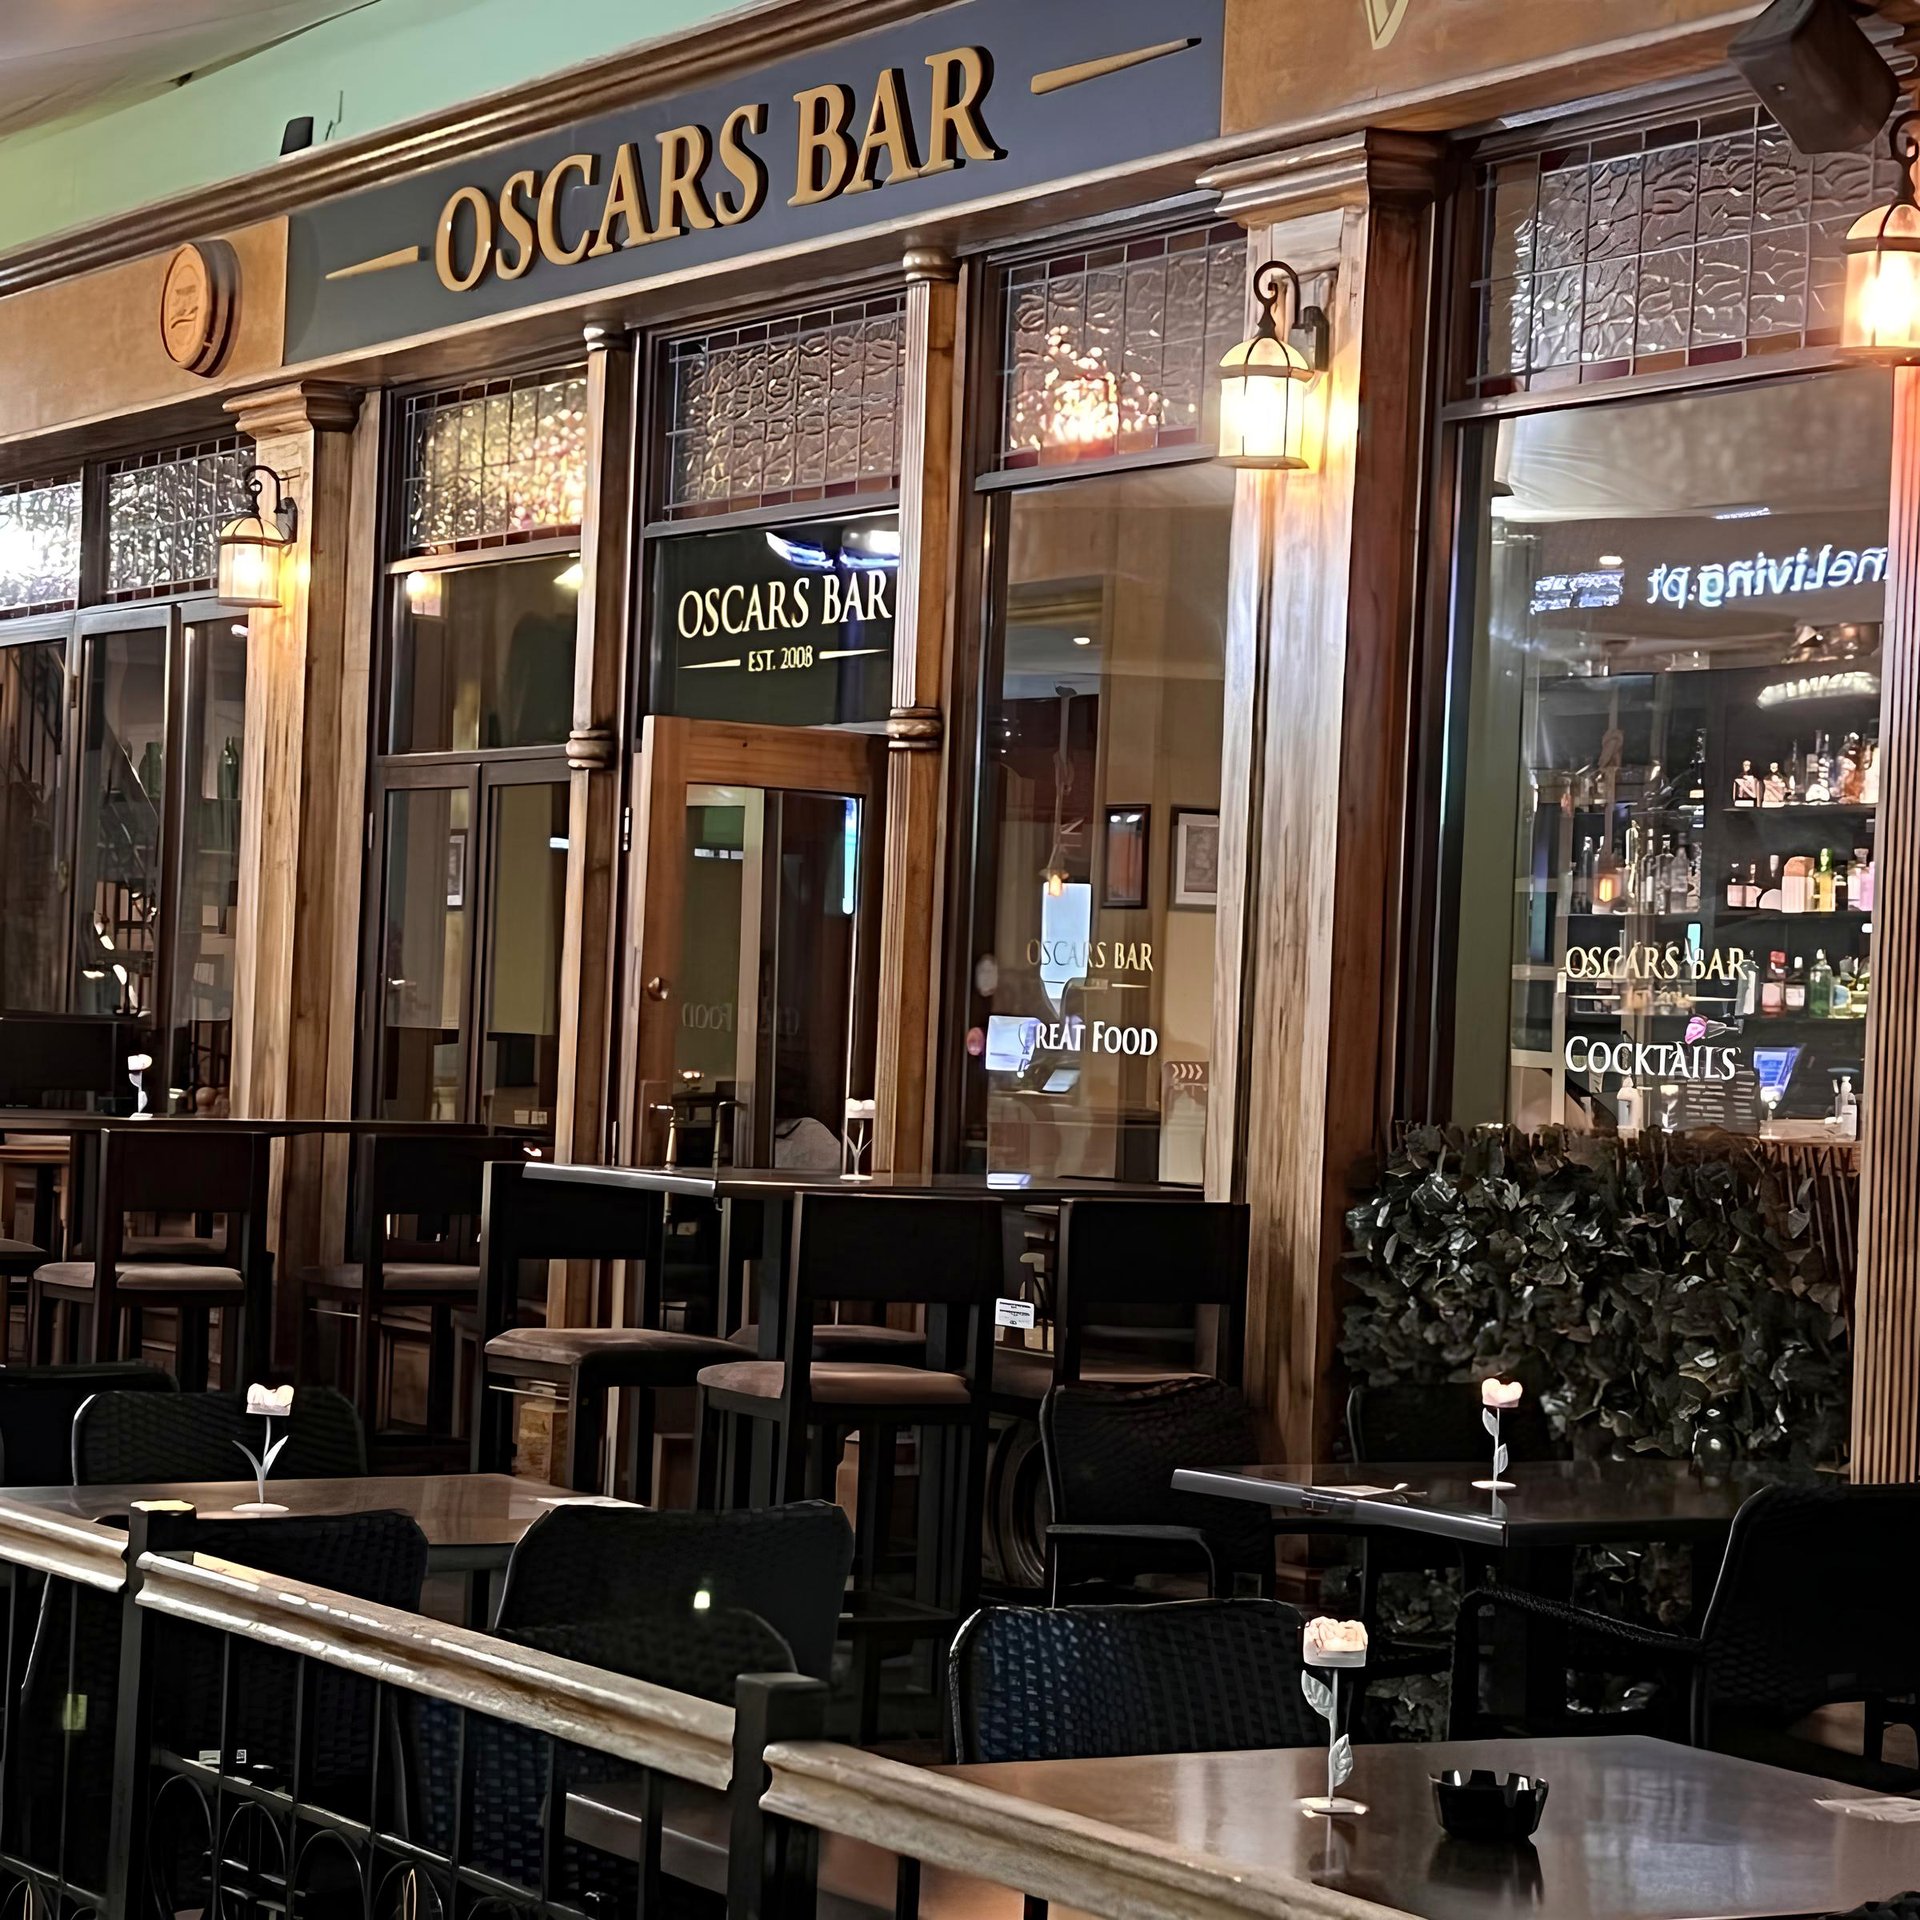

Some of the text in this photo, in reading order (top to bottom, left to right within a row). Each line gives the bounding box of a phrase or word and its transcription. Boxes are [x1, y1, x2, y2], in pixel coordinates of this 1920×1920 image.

[435, 46, 1006, 292] OSCARS BAR
[678, 569, 892, 639] OSCARS BAR
[748, 645, 813, 672] EST. 2008
[1027, 938, 1154, 972] OSCARS BAR
[1565, 946, 1748, 981] OSCARS BAR
[1092, 1020, 1158, 1056] FOOD
[1565, 1035, 1737, 1081] COCKTAILS
